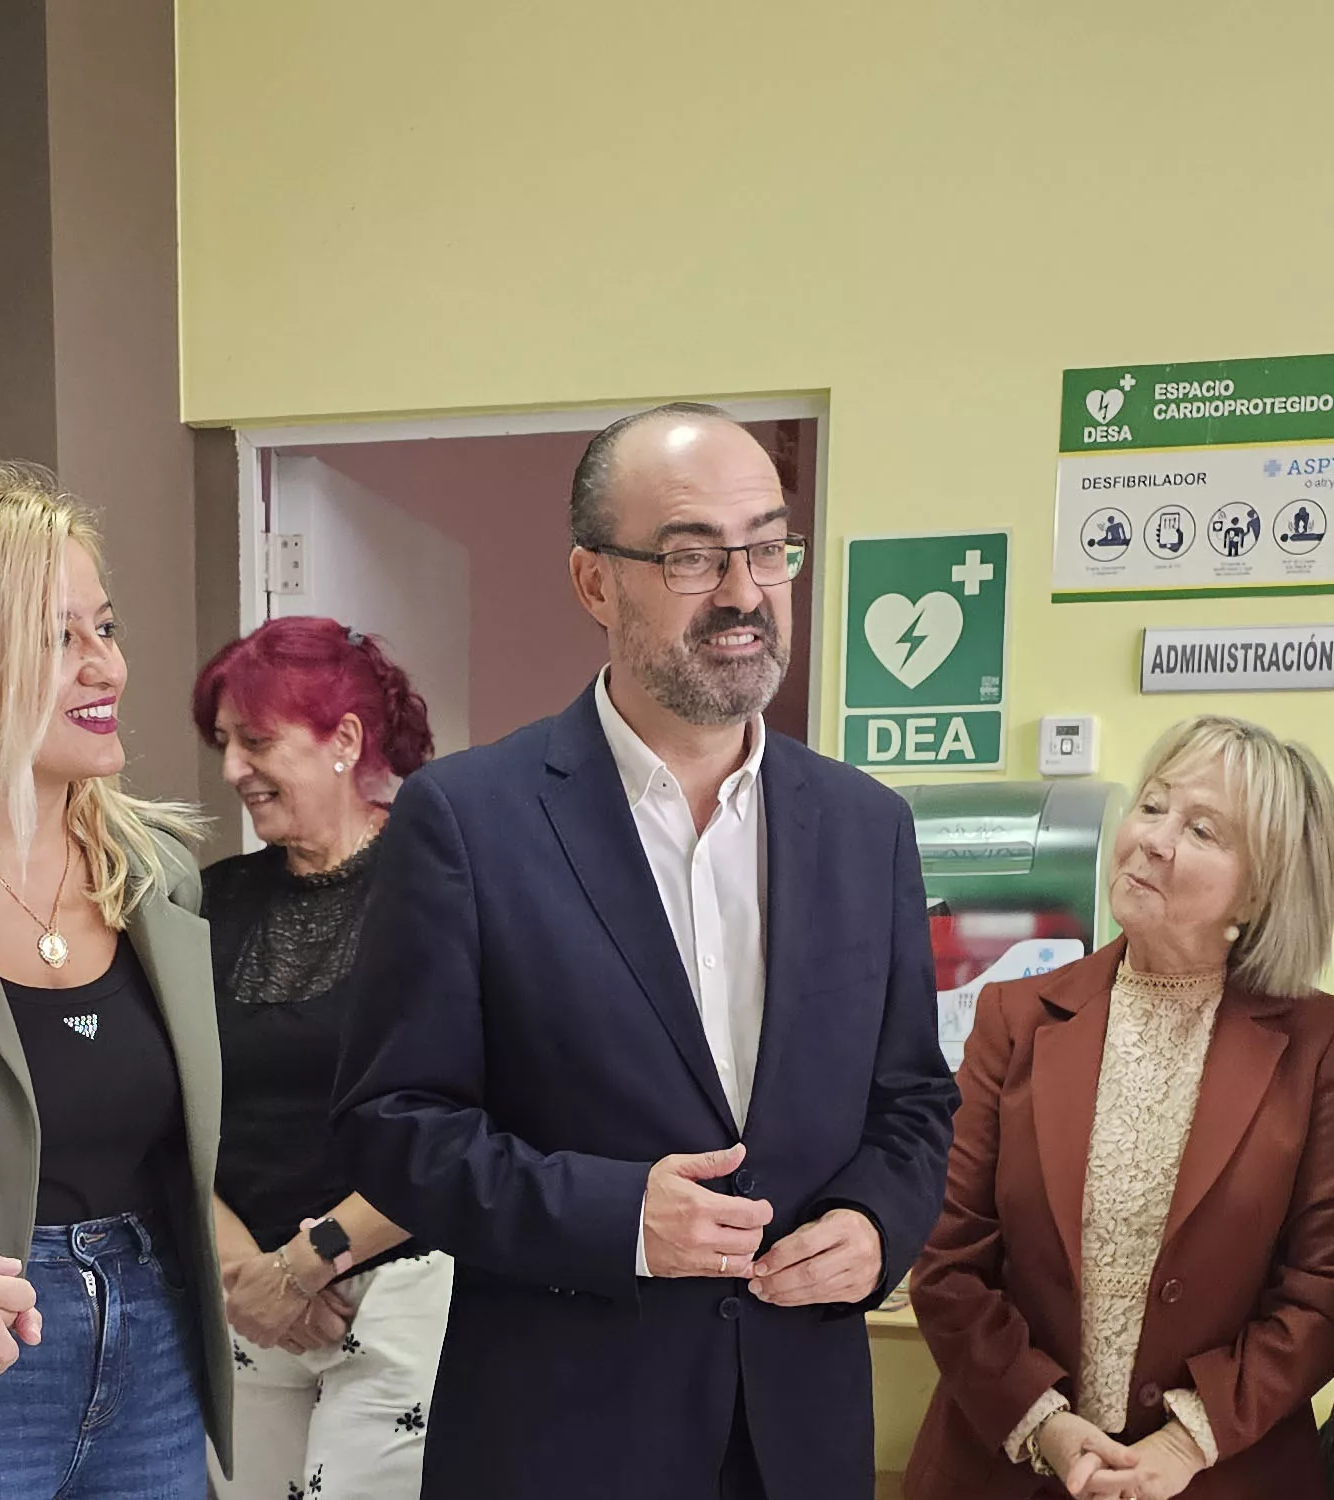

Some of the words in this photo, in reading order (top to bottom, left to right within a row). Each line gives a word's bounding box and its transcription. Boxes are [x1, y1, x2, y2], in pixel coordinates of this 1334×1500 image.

[1153, 379, 1235, 400] ESPACIO
[1152, 394, 1334, 422] CARDIOPROTEGIDO
[1083, 426, 1133, 443] DESA
[1082, 472, 1207, 490] DESFIBRILADOR
[1150, 634, 1334, 675] ADMINISTRACIÓN
[867, 716, 976, 762] DEA
